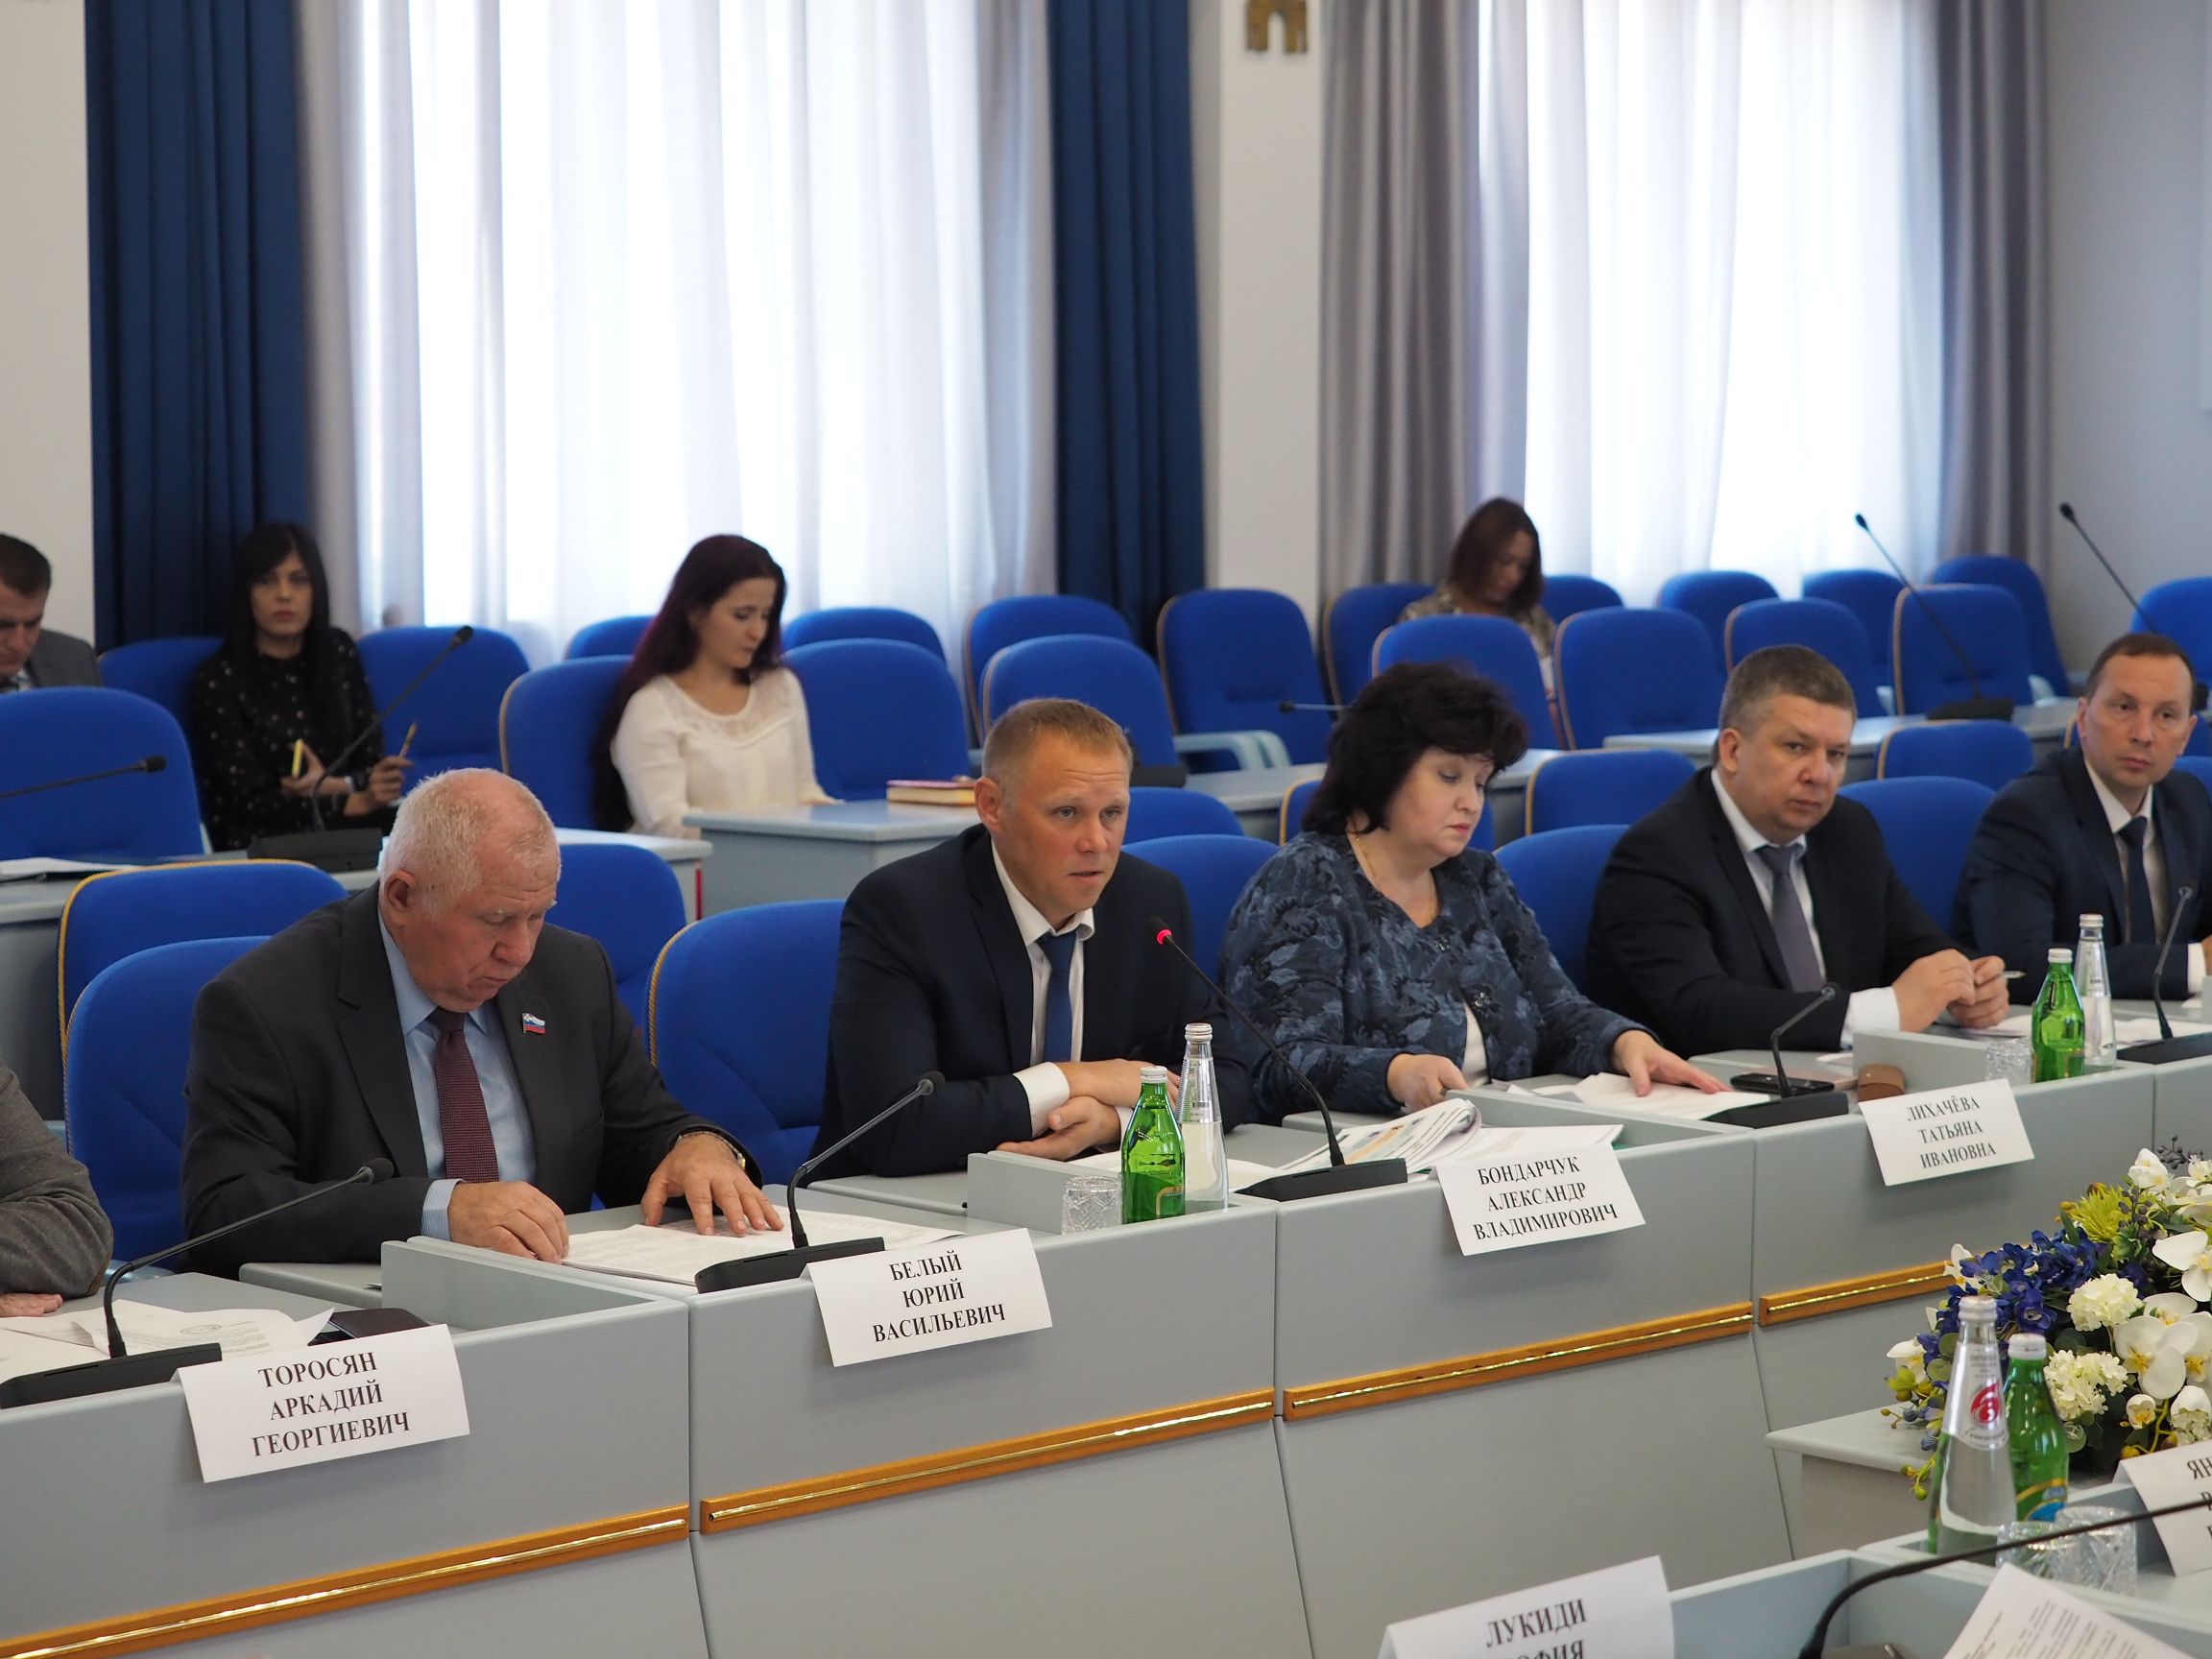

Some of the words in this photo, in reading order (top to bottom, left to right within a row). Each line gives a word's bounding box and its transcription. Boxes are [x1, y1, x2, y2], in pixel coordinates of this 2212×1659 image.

[1907, 1095, 1981, 1121] ЛИХАЧЁВА
[1918, 1119, 1984, 1143] ТАТЬЯНА
[1478, 1156, 1580, 1185] БОНДАРЧУК
[1920, 1142, 1997, 1168] ИВАНОВНА
[1487, 1182, 1586, 1212] АЛЕКСАНДР
[1473, 1203, 1619, 1240] ВЛАДИМИРОВИЧ
[889, 1249, 963, 1281] БЕЛЫЙ
[902, 1277, 966, 1308] ЮРИЙ
[872, 1304, 1005, 1342] ВАСИЛЬЕВИЧ
[258, 1352, 377, 1387] ТОРОСЯН
[270, 1379, 383, 1421] АРКАДИЙ
[252, 1412, 411, 1456] ГЕОРГИЕВИЧ
[1486, 1598, 1587, 1647] ЛУКИДИ
